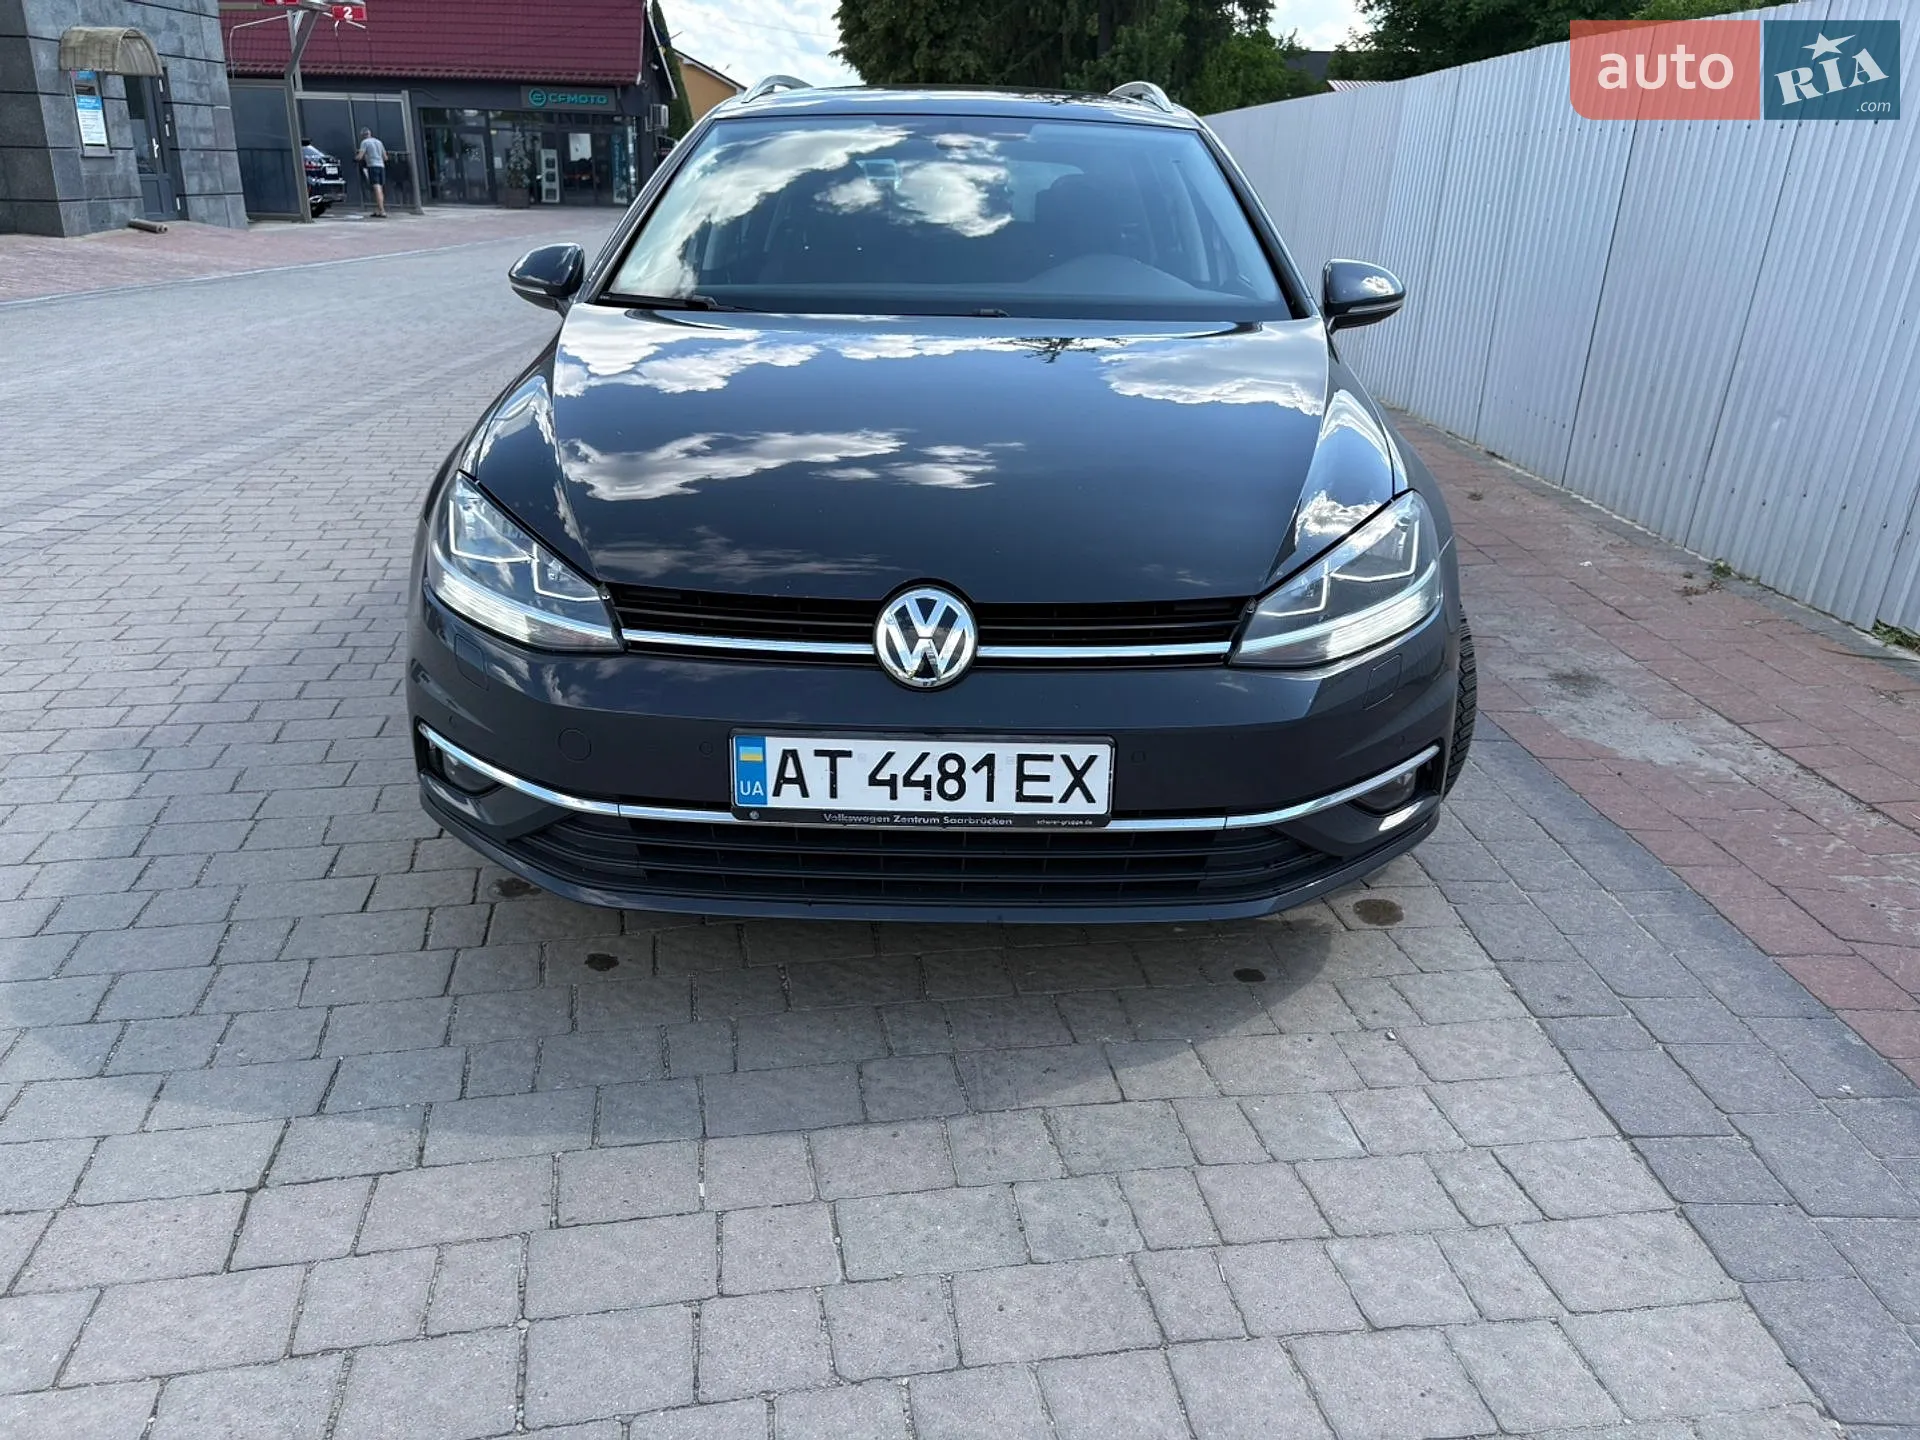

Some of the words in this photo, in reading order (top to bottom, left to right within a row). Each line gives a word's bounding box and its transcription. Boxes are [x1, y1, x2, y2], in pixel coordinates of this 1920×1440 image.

[343, 6, 353, 20] 2
[548, 92, 608, 104] CFMOTO
[772, 749, 853, 799] AT
[868, 751, 995, 802] 4481
[1015, 753, 1099, 804] EX
[740, 781, 764, 796] UA
[823, 813, 890, 825] Volkswagen
[893, 814, 940, 825] Zentrum
[943, 815, 1013, 826] Saarbrücken
